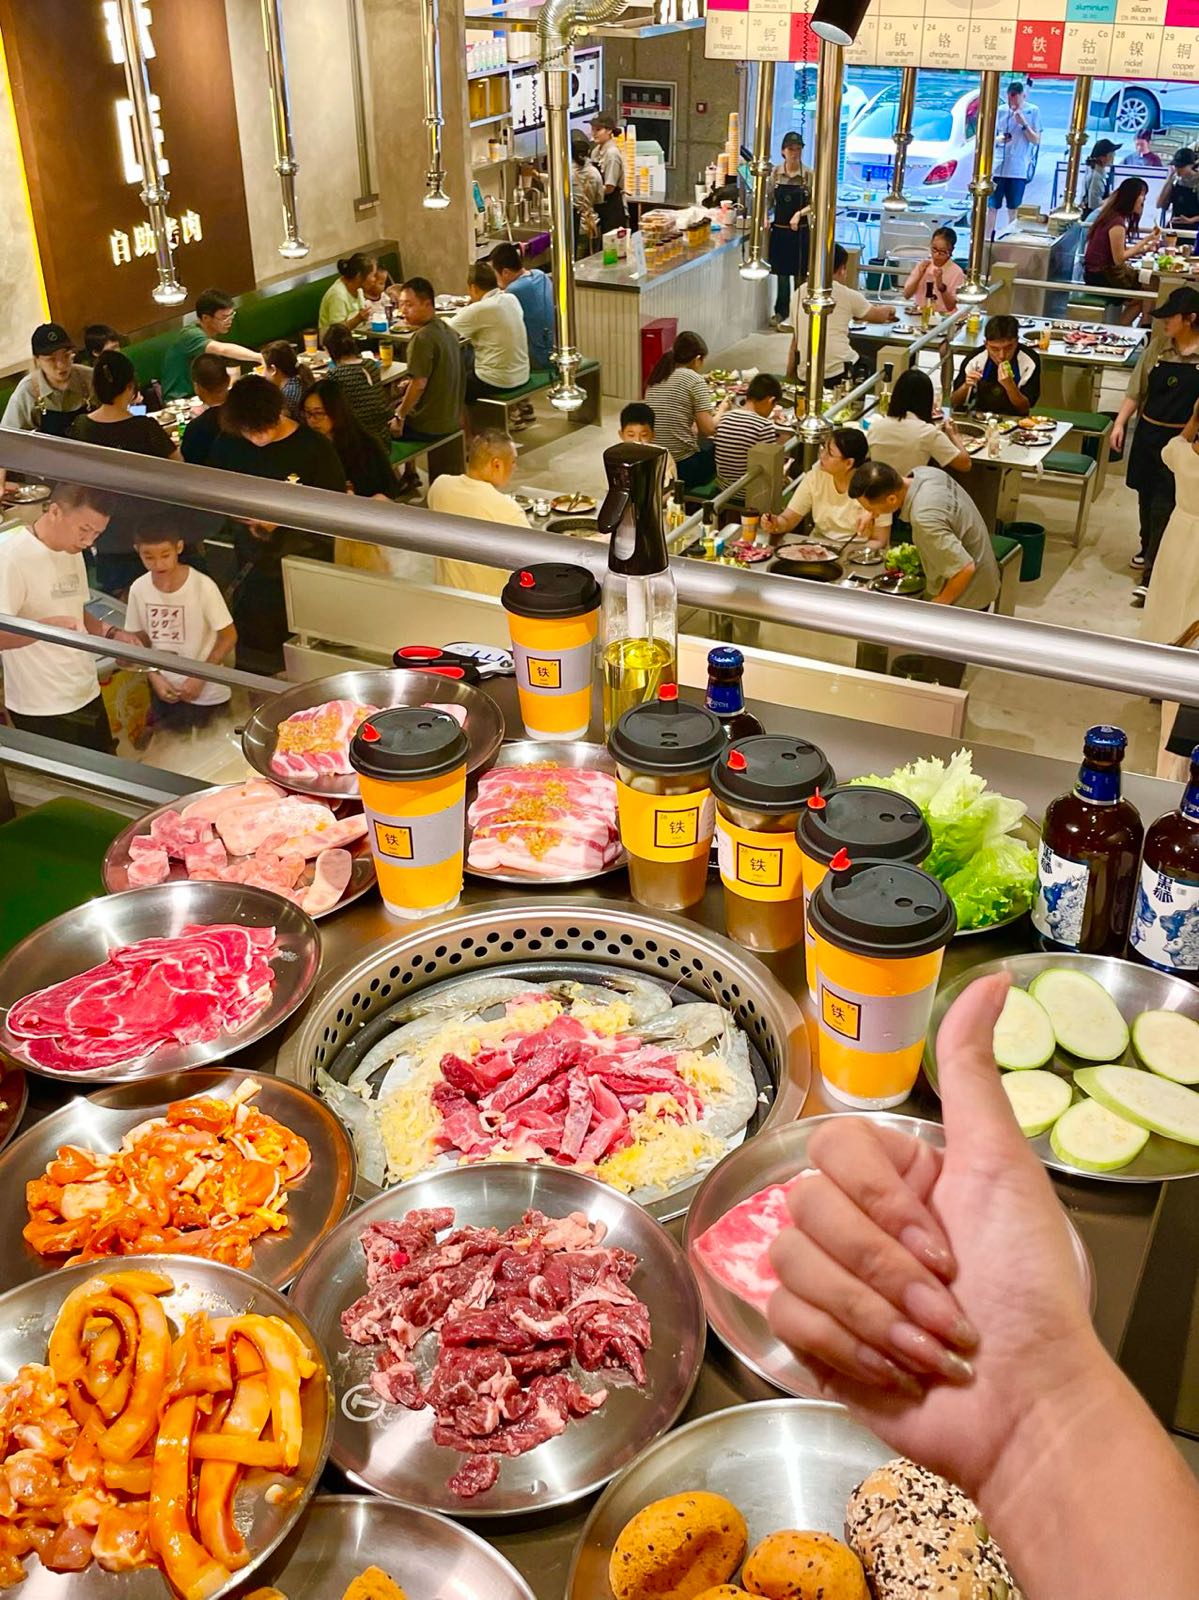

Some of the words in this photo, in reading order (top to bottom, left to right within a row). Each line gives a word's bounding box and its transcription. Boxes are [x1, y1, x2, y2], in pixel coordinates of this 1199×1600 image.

[1131, 5, 1152, 13] silicon
[972, 25, 982, 33] 25
[1022, 25, 1033, 34] 26
[1050, 26, 1061, 35] Fe
[1068, 29, 1079, 37] 27
[1098, 30, 1109, 38] Co
[1116, 31, 1126, 39] 28
[1145, 32, 1155, 40] Ni
[1165, 33, 1175, 41] 29
[1031, 36, 1047, 54] 铁
[1082, 38, 1097, 55] 钴
[1129, 40, 1144, 57] 镍
[929, 51, 960, 59] chromium
[1177, 42, 1192, 59] 铜
[1077, 56, 1098, 65] cobalt
[1124, 59, 1143, 67] nickel
[1172, 63, 1195, 71] copper
[536, 666, 550, 678] 铁
[669, 820, 685, 834] 铁
[385, 832, 399, 846] 铁
[750, 857, 766, 872] 铁
[831, 1003, 845, 1022] 铁
